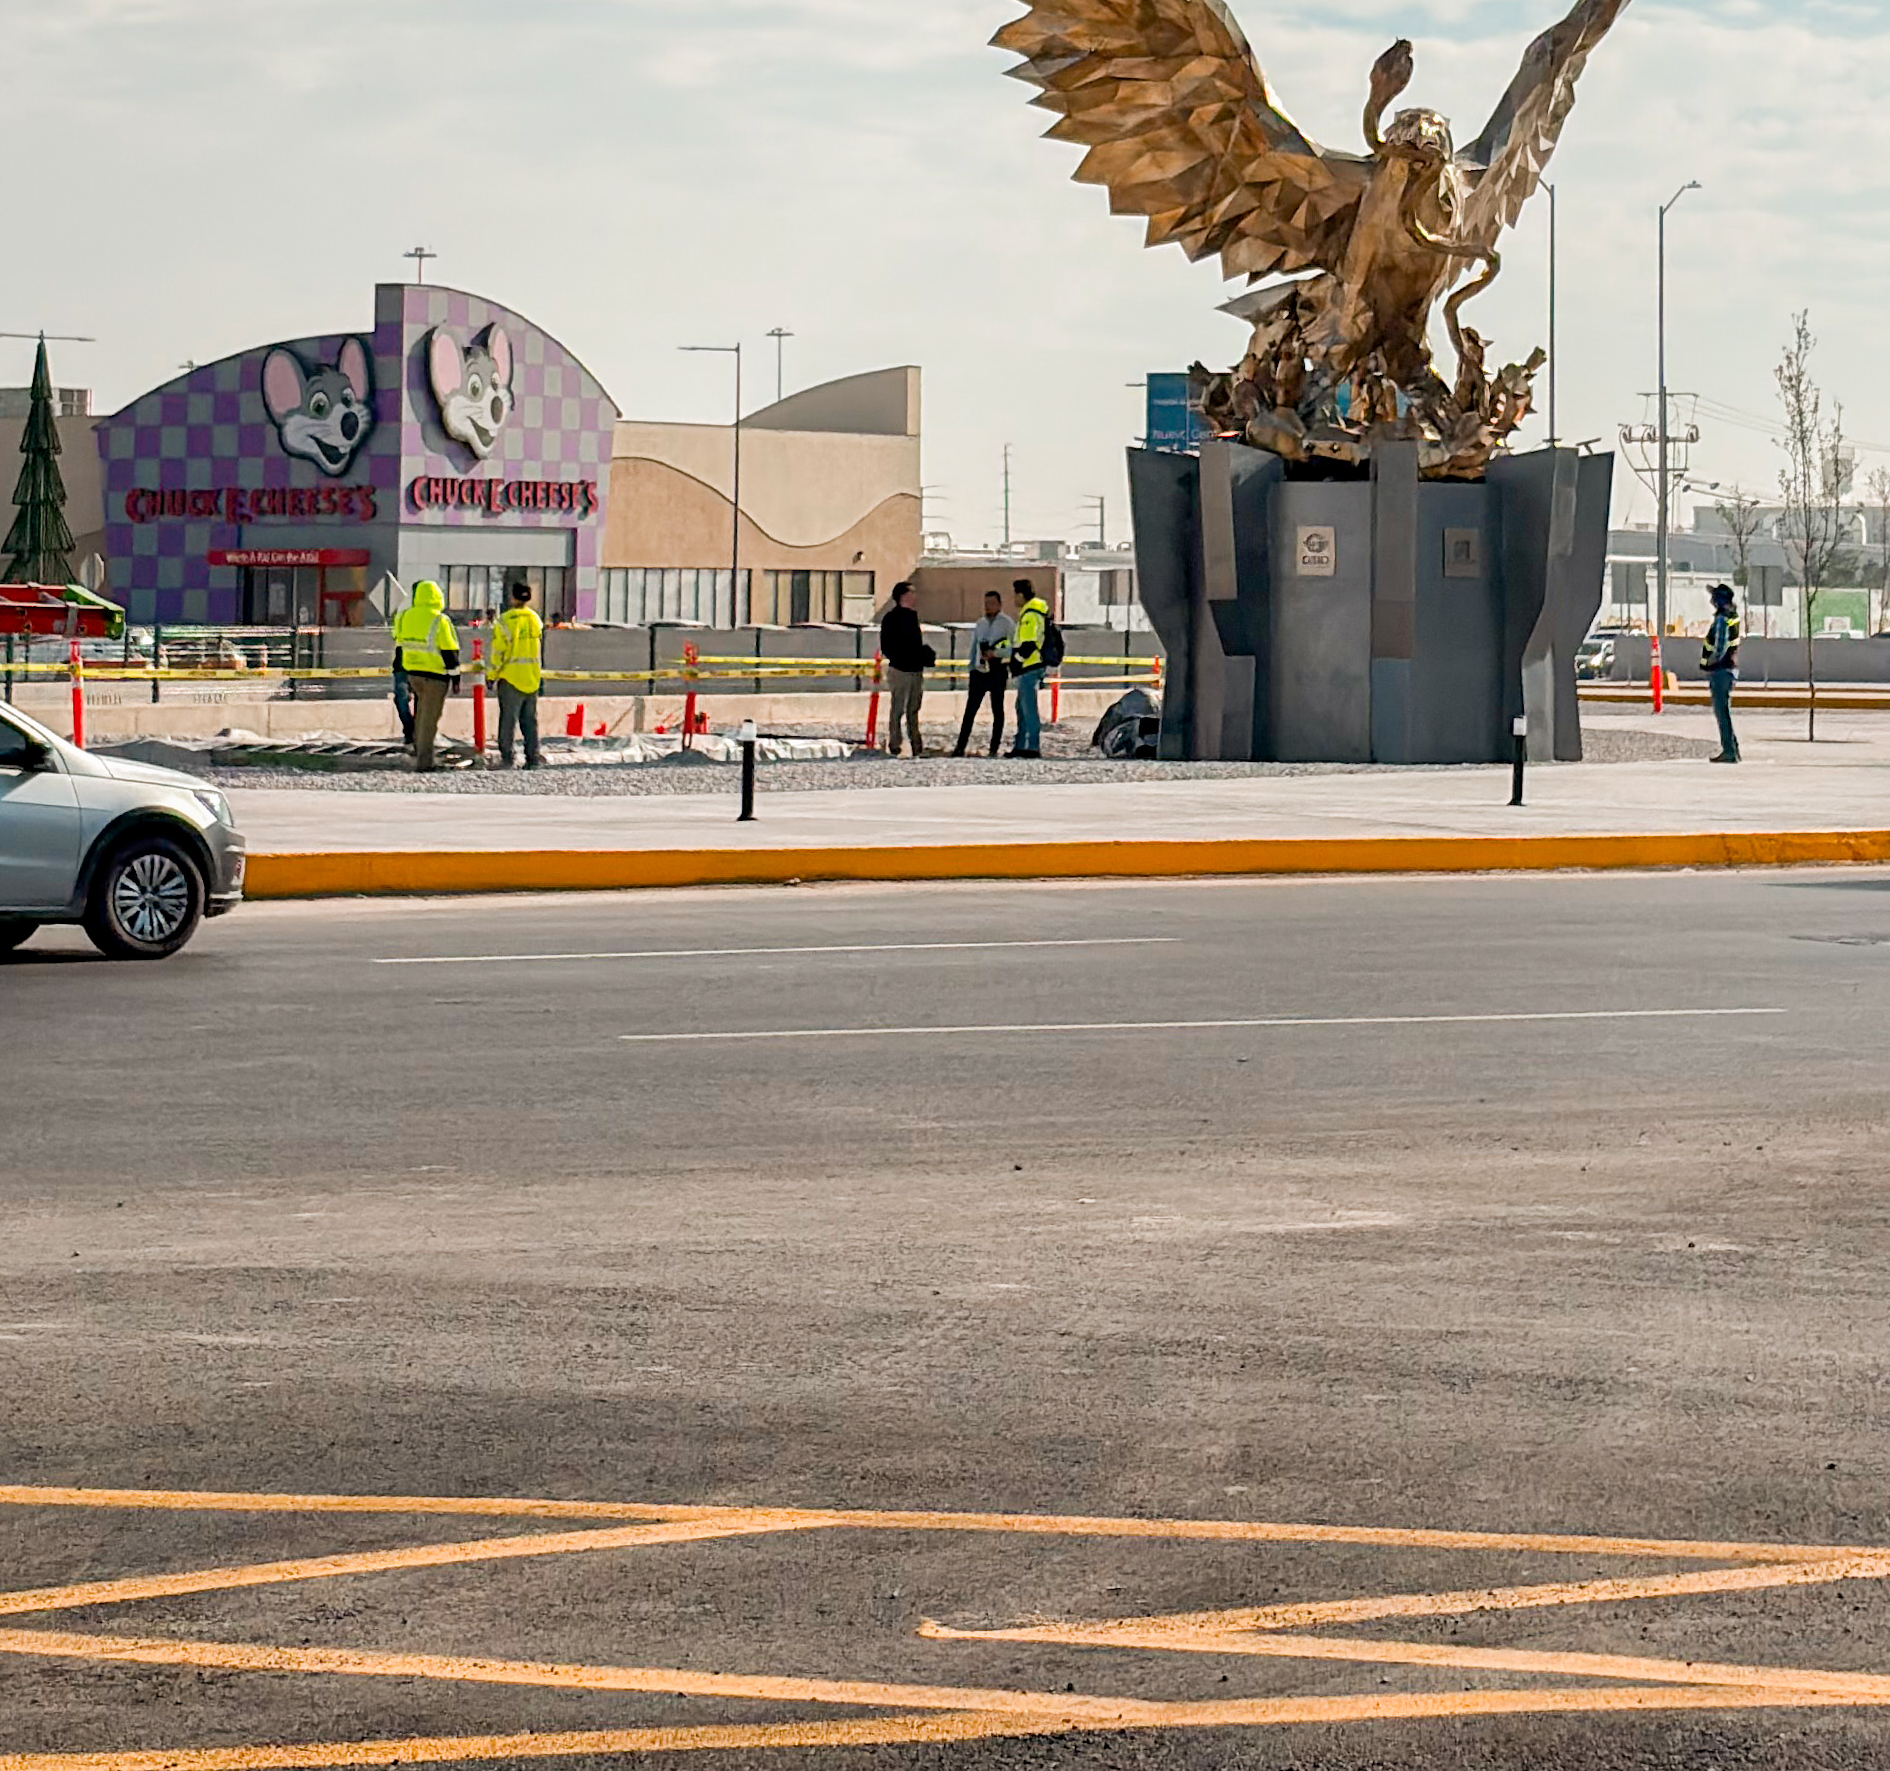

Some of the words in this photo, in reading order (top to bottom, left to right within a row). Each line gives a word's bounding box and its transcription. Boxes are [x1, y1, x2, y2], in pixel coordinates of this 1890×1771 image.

[125, 487, 220, 523] CHUCK
[250, 485, 377, 522] CHEESE'S
[412, 475, 487, 511] CHUCK
[507, 480, 599, 516] CHEESE'S
